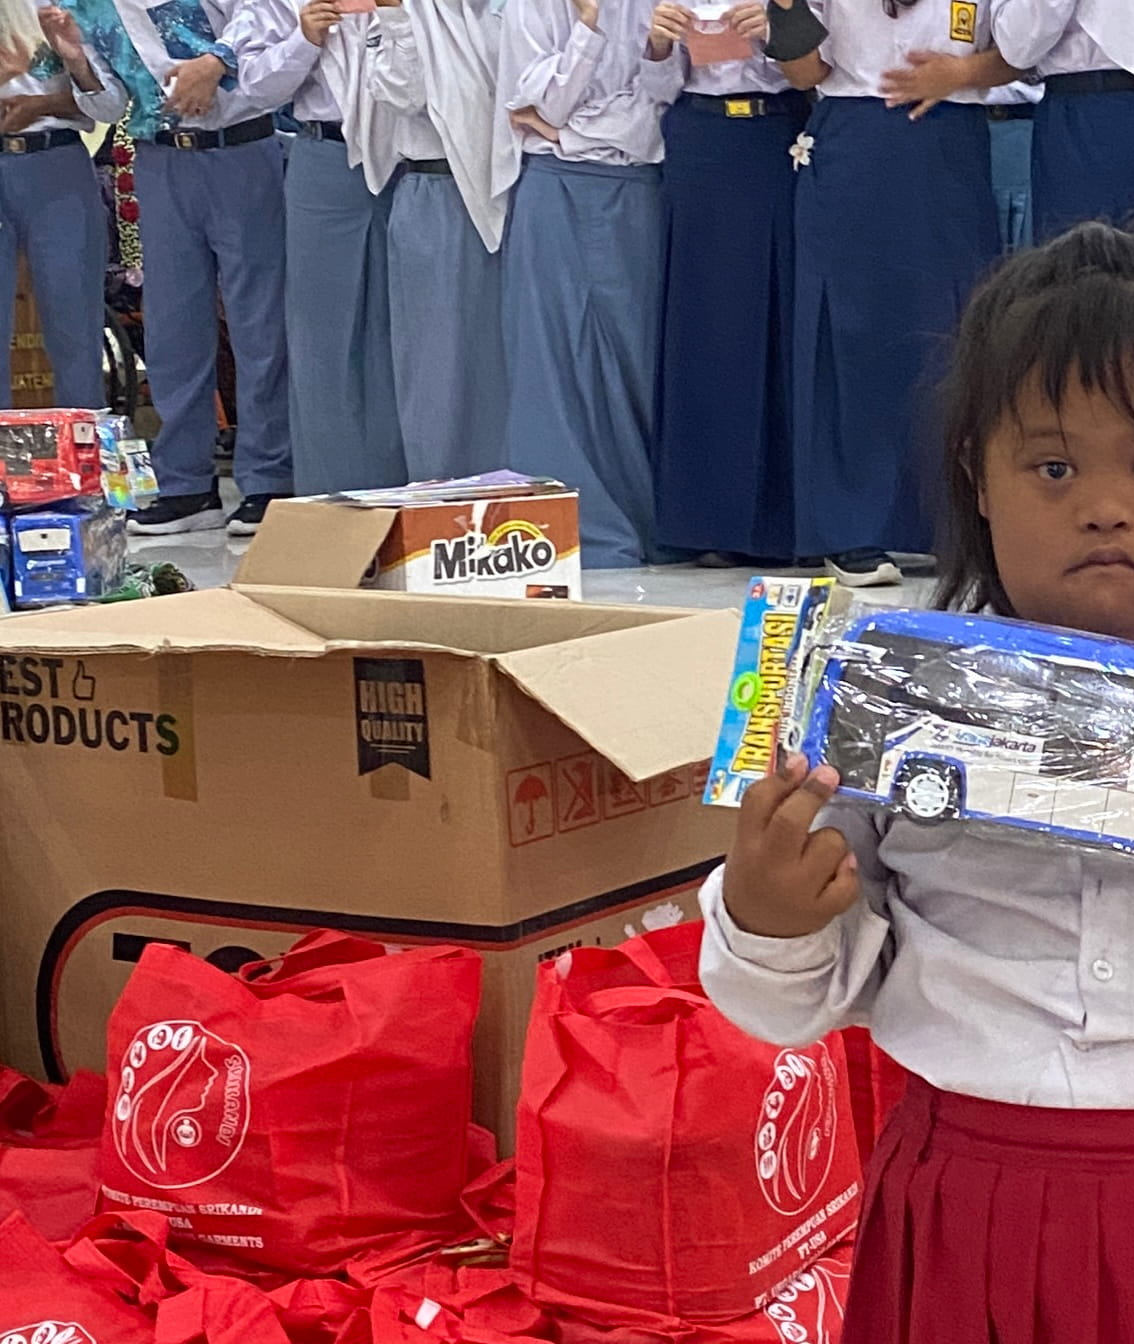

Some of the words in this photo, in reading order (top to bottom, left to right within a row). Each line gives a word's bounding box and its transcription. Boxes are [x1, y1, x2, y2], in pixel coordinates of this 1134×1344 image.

[433, 534, 552, 580] Mikako
[360, 680, 424, 715] HIGH
[732, 612, 799, 774] TRANSPORTASI
[360, 719, 423, 743] QUALITY
